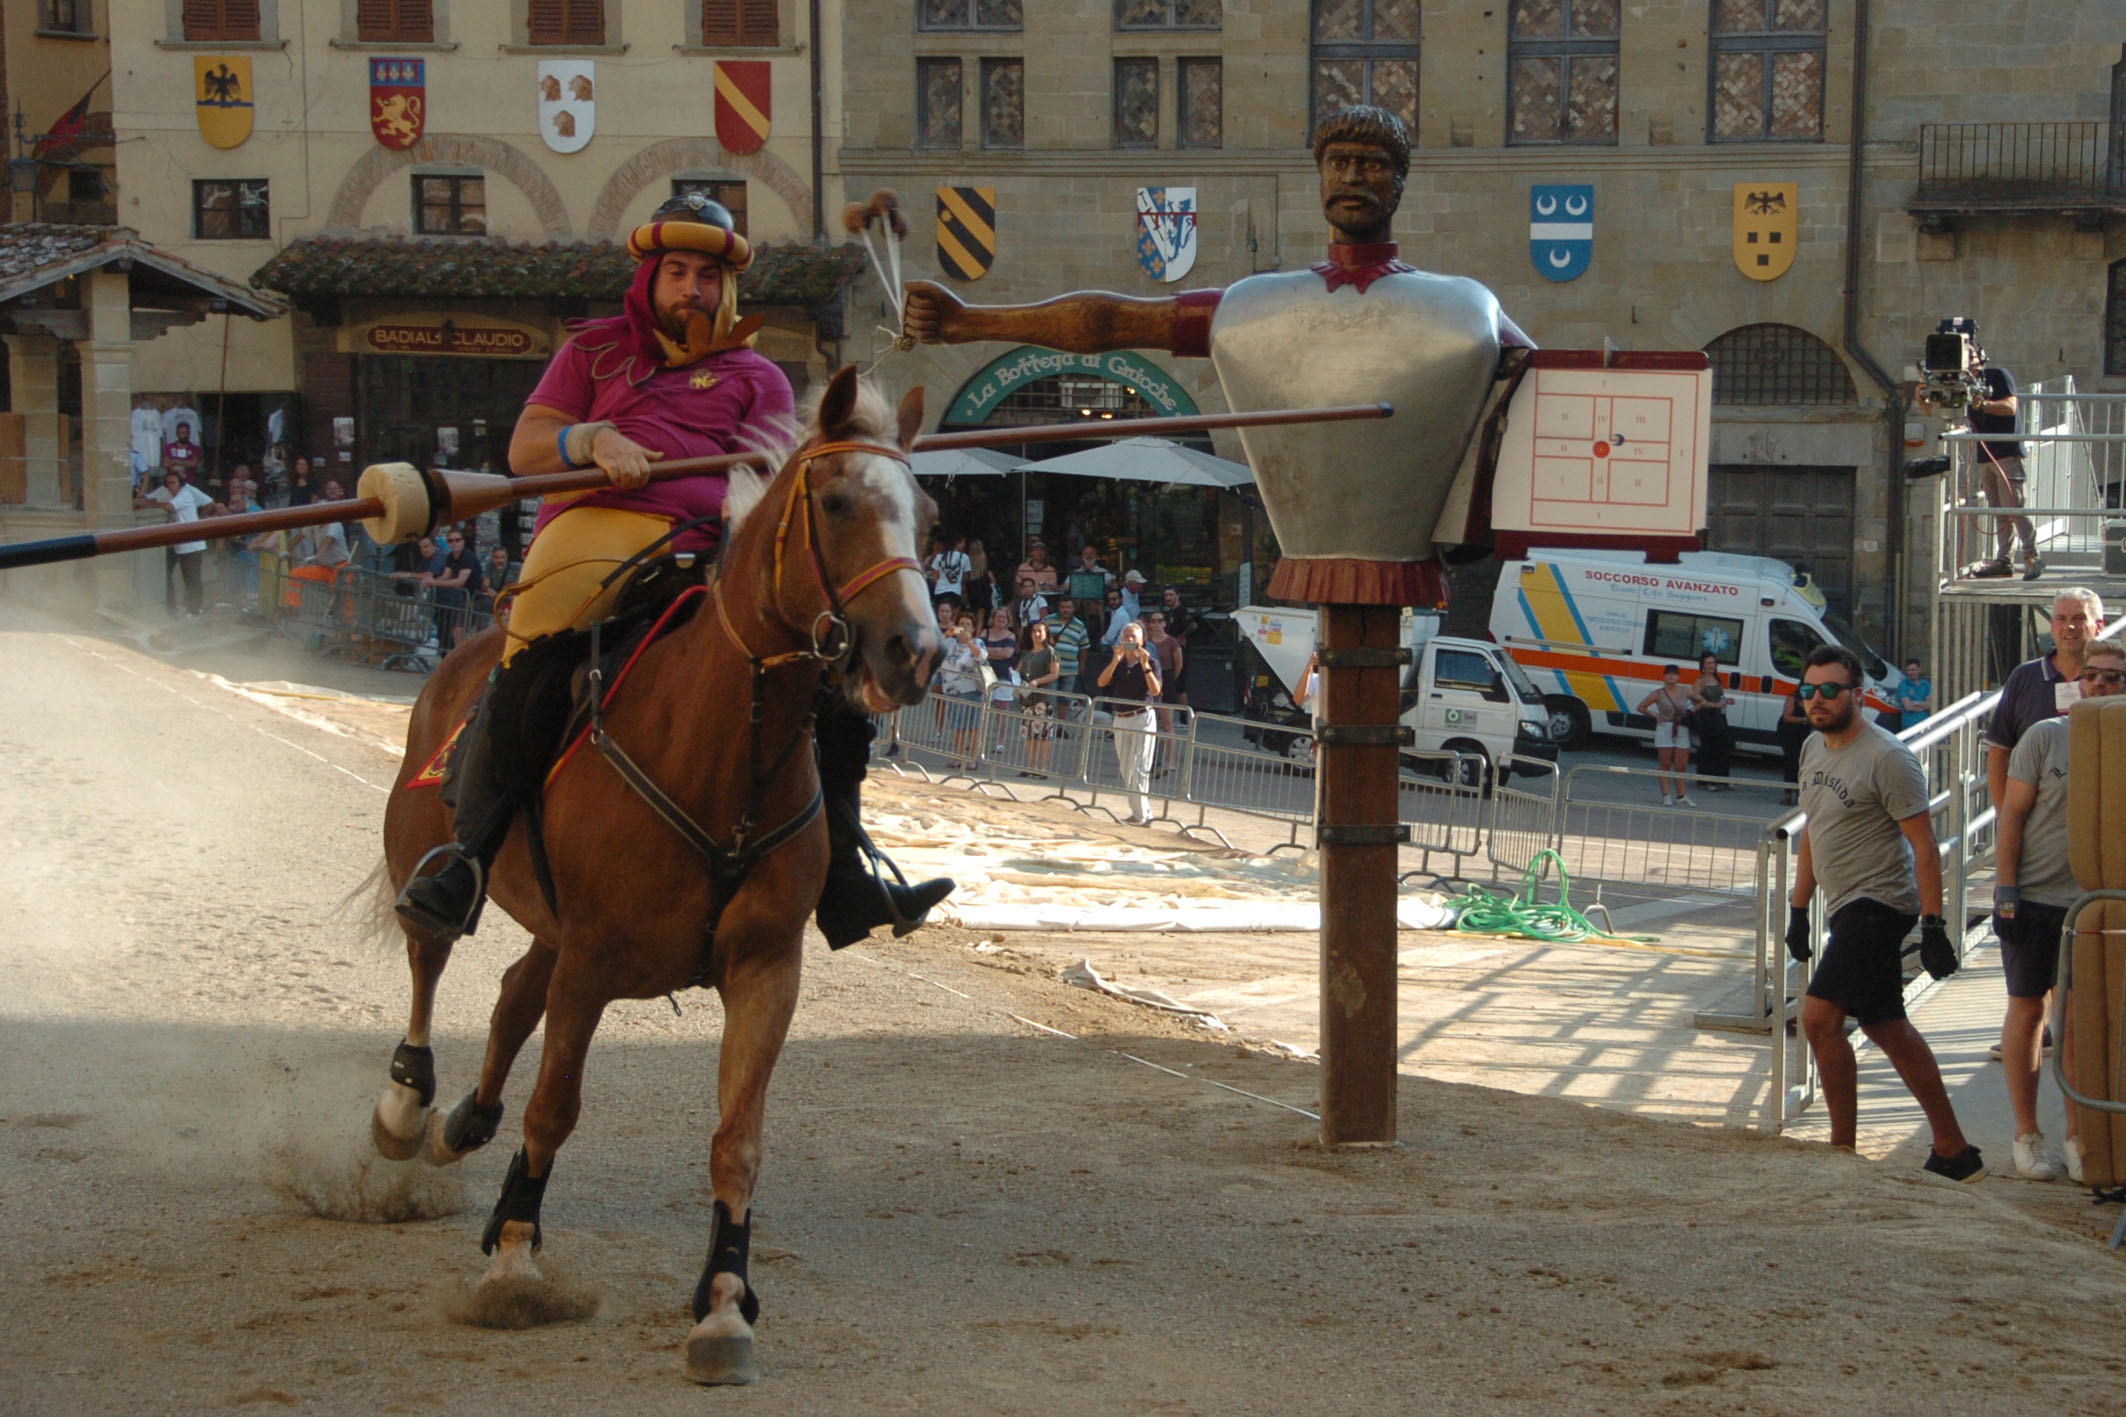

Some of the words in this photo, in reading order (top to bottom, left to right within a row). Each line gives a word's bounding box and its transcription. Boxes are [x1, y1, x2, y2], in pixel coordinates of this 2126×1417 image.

[451, 330, 524, 347] CLAUDIO
[967, 383, 996, 408] La
[995, 353, 1075, 387] Bottega
[1585, 570, 1659, 587] SOCCORSO
[1666, 579, 1739, 597] AVANZATO
